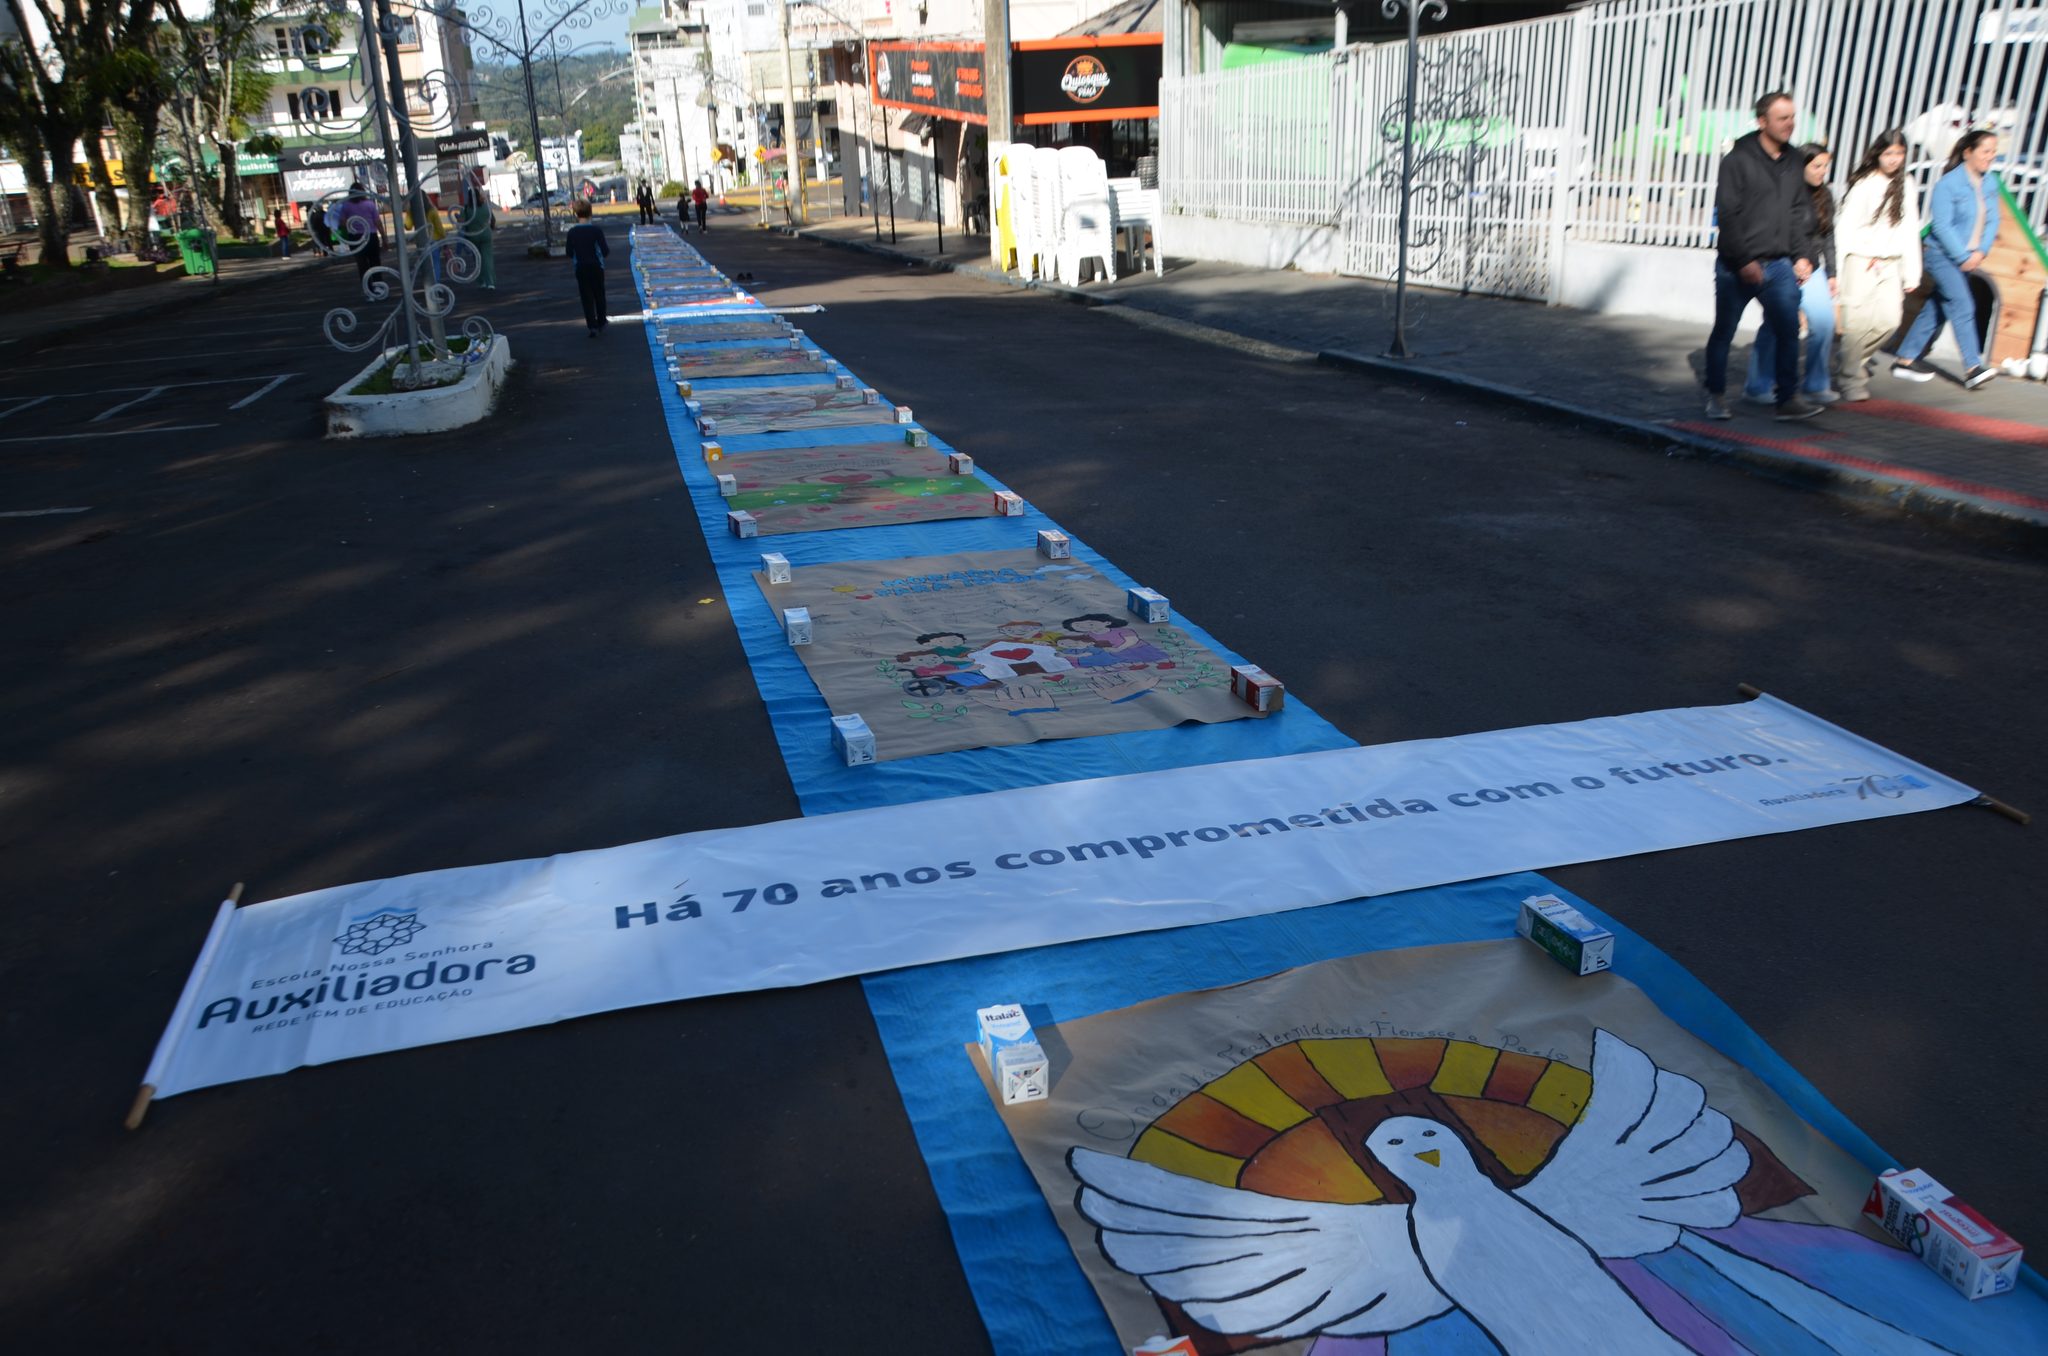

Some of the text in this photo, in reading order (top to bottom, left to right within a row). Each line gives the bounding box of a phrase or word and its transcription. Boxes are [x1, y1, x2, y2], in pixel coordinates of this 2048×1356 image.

[615, 752, 1790, 929] Há 70 anos comprometida com o futuro.
[196, 954, 537, 1030] Auxiliadora
[250, 941, 495, 990] Escola Nossa Senhora
[252, 987, 474, 1033] REDE ICM DE EDUCAÇÃO
[984, 1008, 1021, 1022] Italac
[1076, 1086, 1182, 1141] Onde
[1468, 1034, 1480, 1043] a
